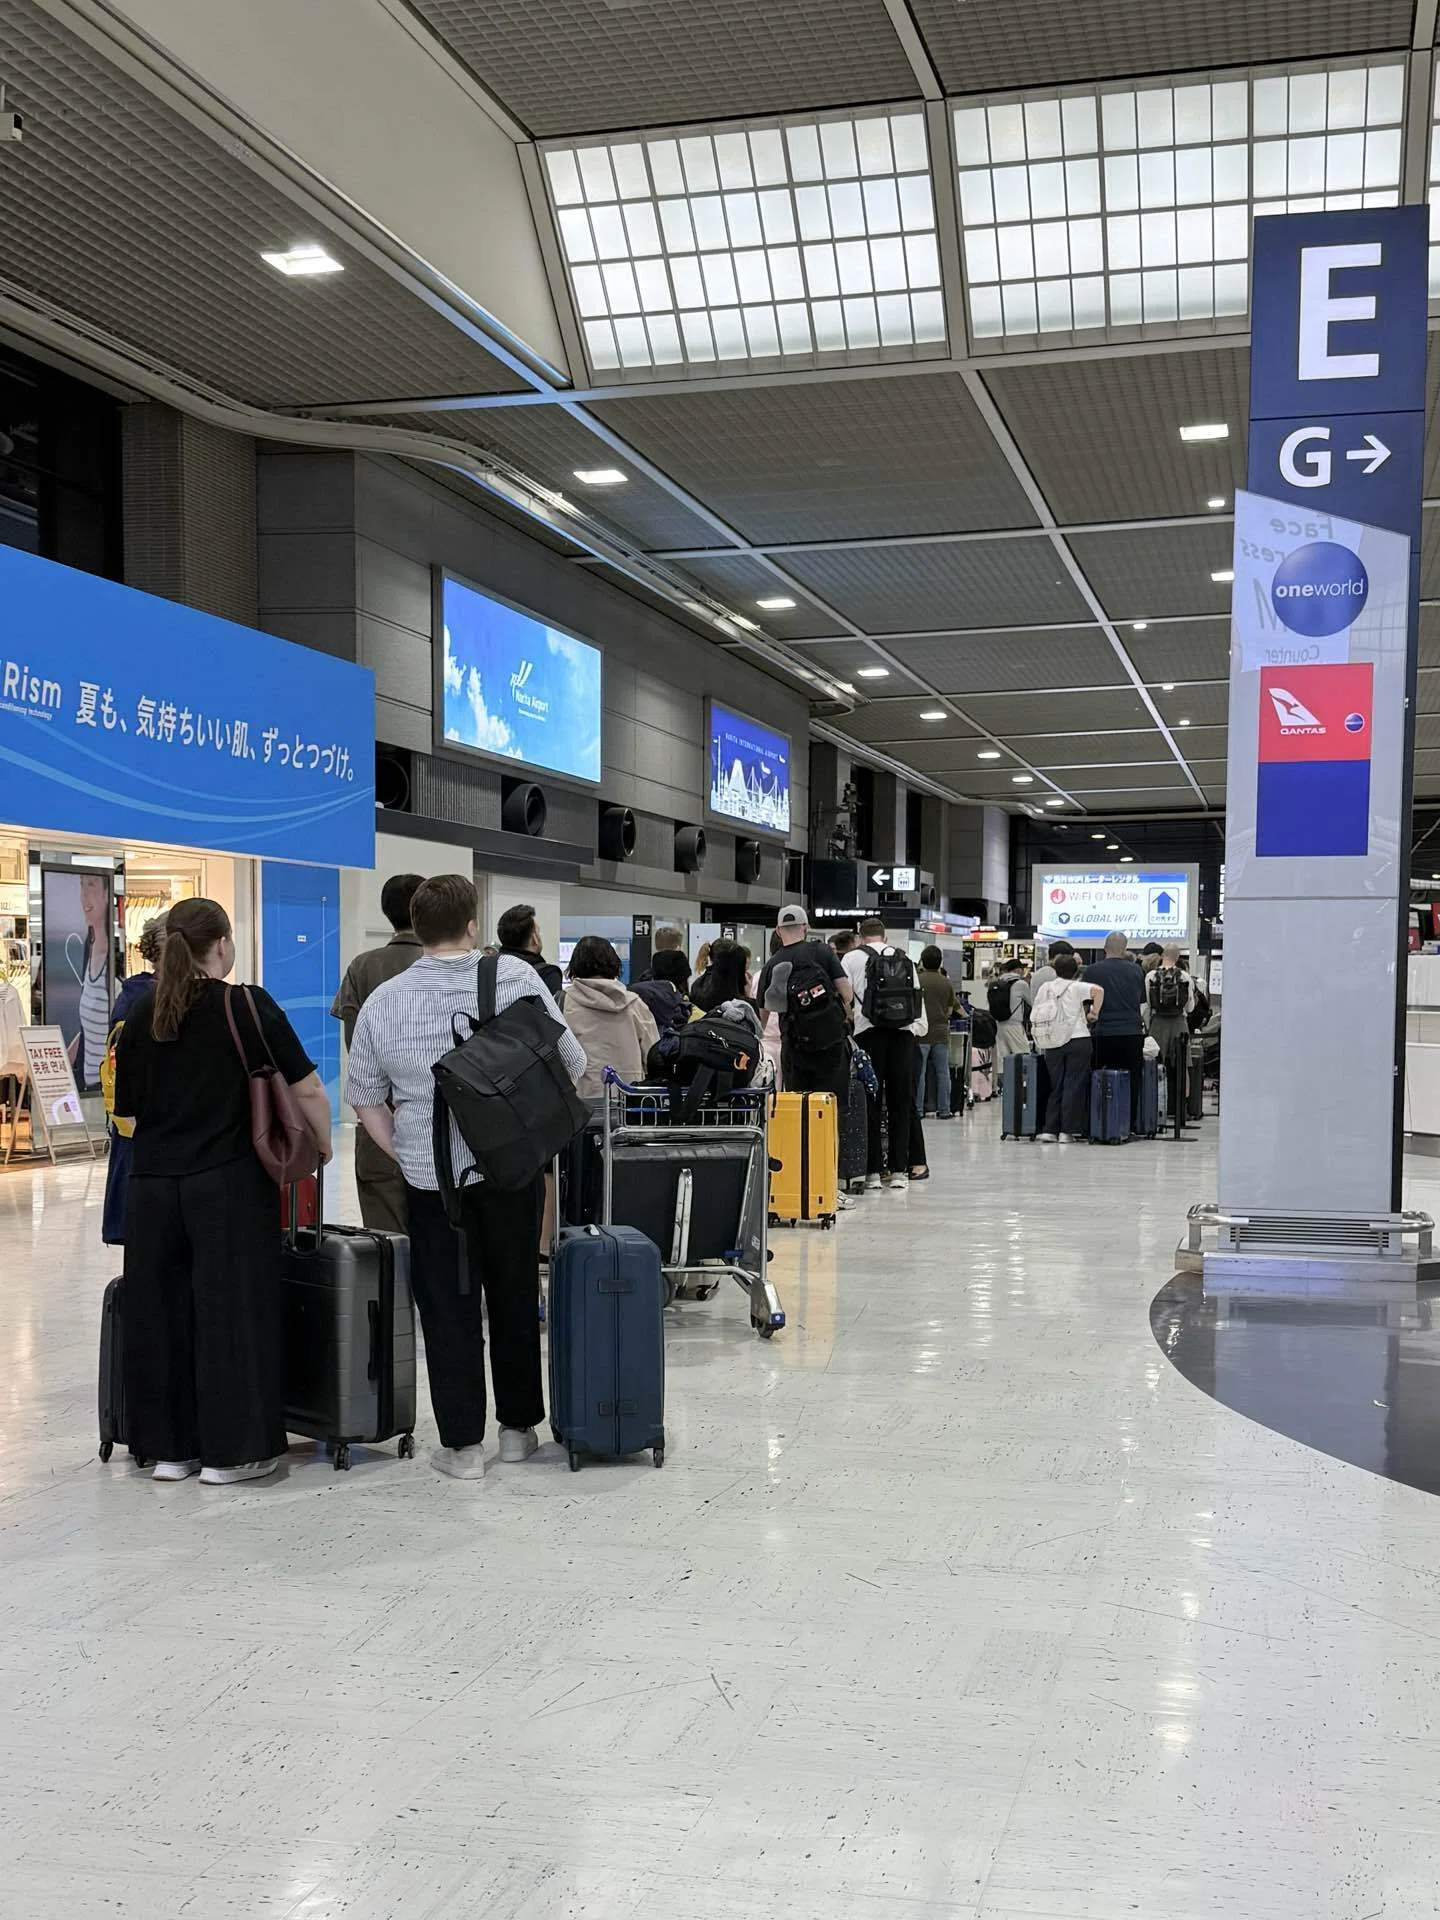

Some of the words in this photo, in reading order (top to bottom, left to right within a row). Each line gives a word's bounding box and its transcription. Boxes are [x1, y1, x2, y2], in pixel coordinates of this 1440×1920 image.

[1299, 243, 1382, 380] E
[1279, 426, 1332, 487] G
[1276, 578, 1364, 598] oneworld
[0, 659, 61, 709] Rism
[1280, 727, 1326, 735] QANTAS
[1073, 913, 1112, 923] GLOBAL
[28, 1048, 43, 1059] TAX
[43, 1047, 63, 1058] FREE
